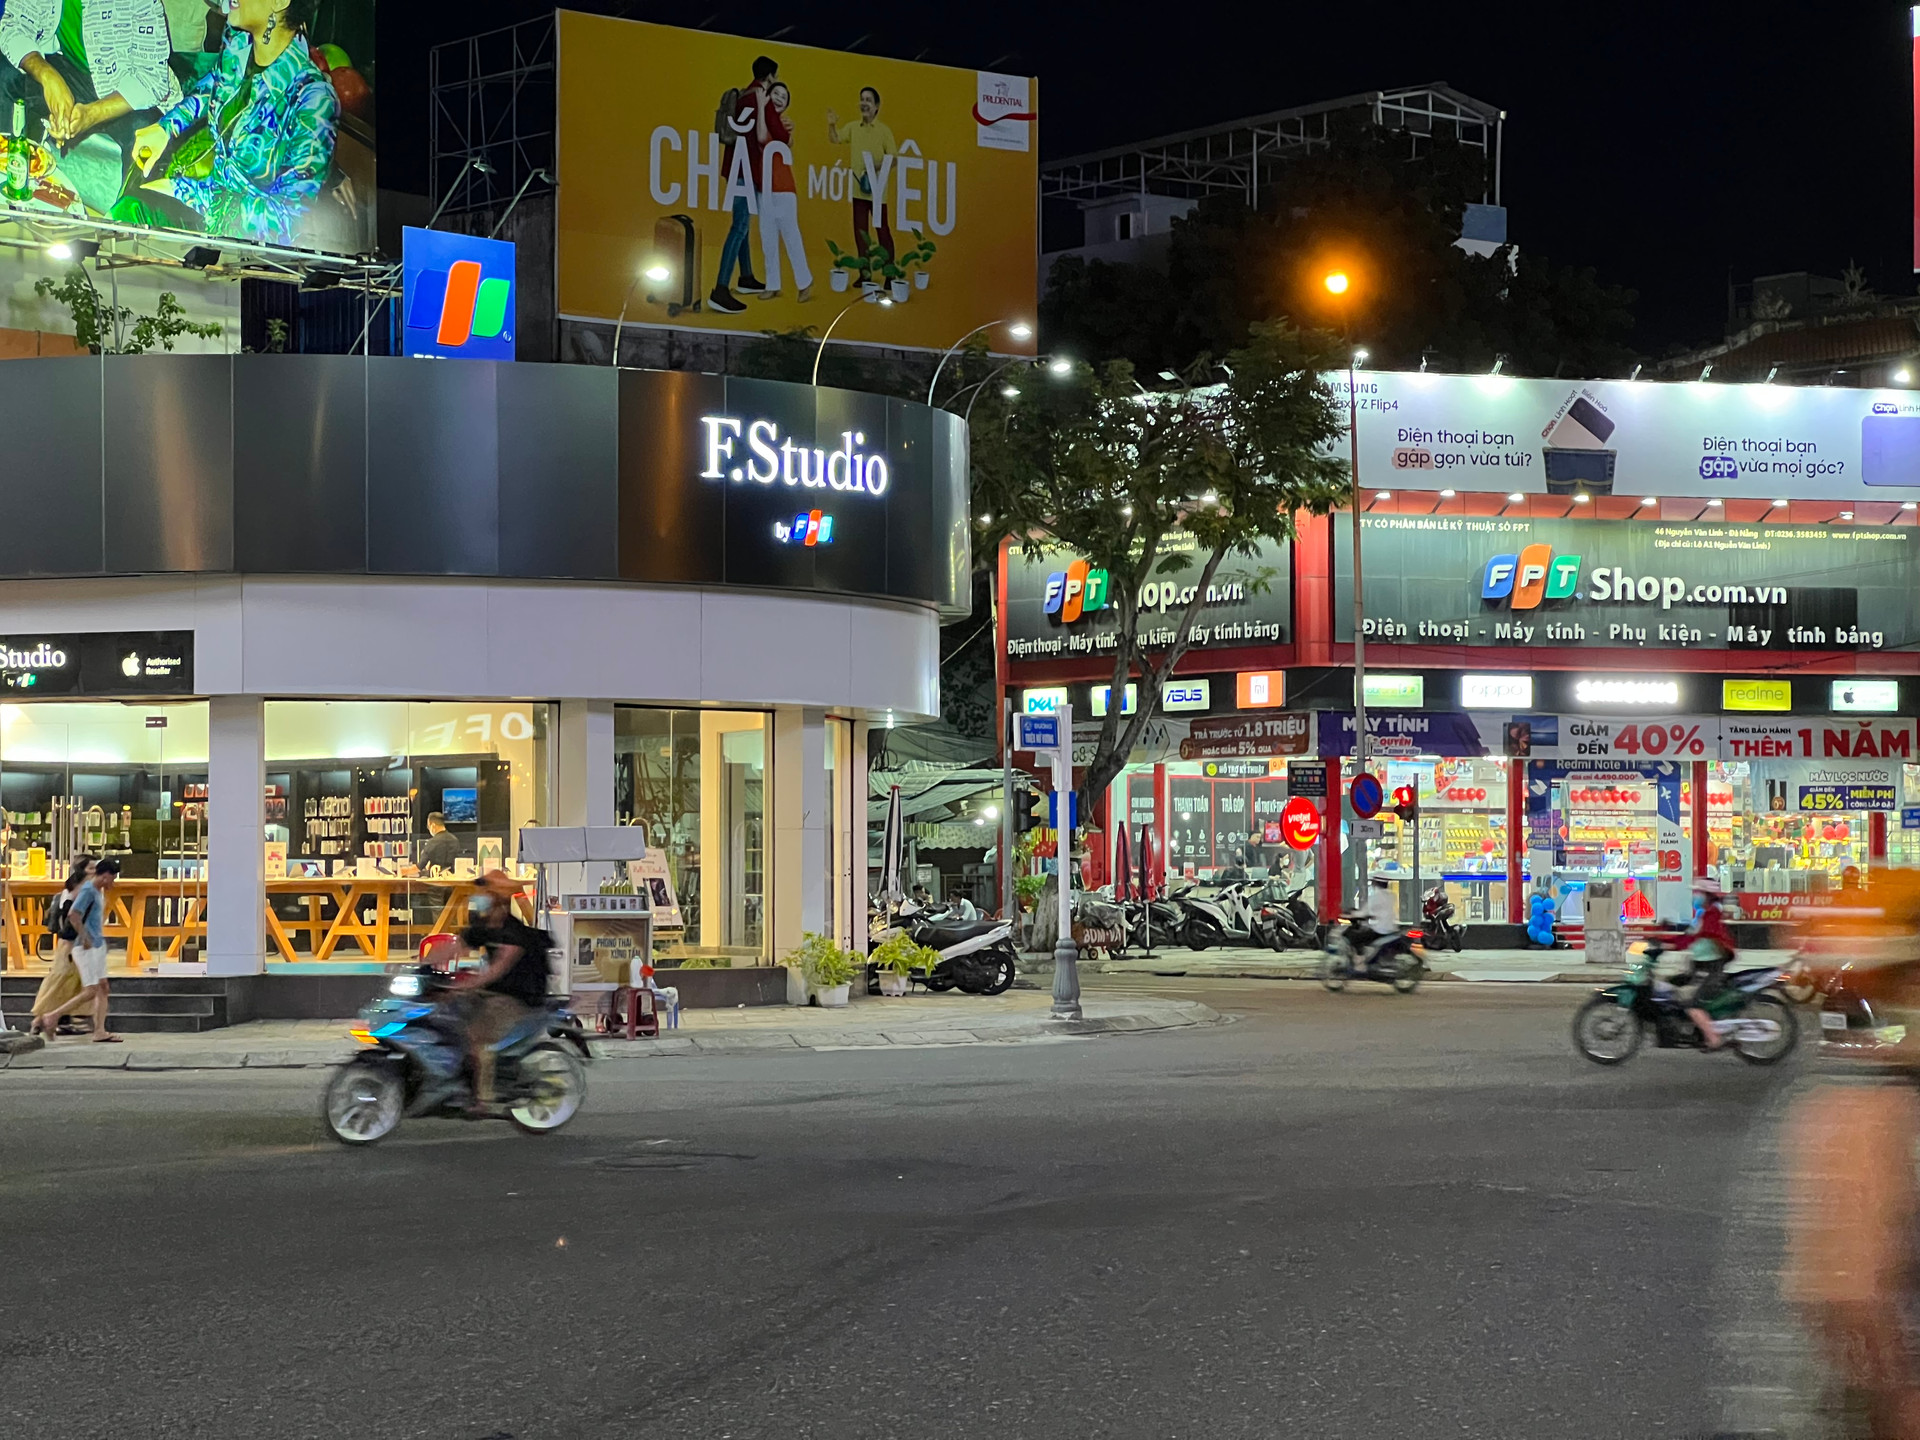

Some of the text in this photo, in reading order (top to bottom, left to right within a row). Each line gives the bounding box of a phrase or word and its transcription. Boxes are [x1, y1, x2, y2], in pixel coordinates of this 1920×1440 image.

[982, 95, 1023, 107] PRUDENTIAL
[808, 160, 853, 203] MỚI
[861, 139, 957, 236] YÊU
[1371, 398, 1398, 413] Flip4
[1398, 428, 1514, 449] Điện thoại bạn
[1703, 437, 1817, 457] Điện thoại bạn
[700, 415, 888, 496] F.Studio
[1397, 450, 1532, 469] gập gọn vừa túi?
[1702, 456, 1845, 478] gập vừa mọi góc?
[774, 520, 791, 542] by
[1360, 518, 1373, 528] TY
[1417, 517, 1436, 530] BÁN
[1466, 520, 1496, 533] THUẬT
[1513, 523, 1530, 533] FPT
[1007, 638, 1032, 657] Điện
[1033, 637, 1062, 654] thoại
[1069, 634, 1094, 653] Máy
[1214, 621, 1241, 640] tính
[1242, 619, 1280, 641] bảng
[1362, 618, 1884, 648] Điện thoại Máy tính Phụ kiện Máy tính bảng
[1166, 688, 1203, 703] ASUS
[1730, 686, 1784, 701] realme
[1245, 722, 1263, 737] 1.8
[1264, 716, 1306, 740] TRIỆU
[1386, 714, 1429, 733] TÍNH
[1570, 719, 1609, 737] GIẢM
[1238, 740, 1256, 755] 5%
[1258, 745, 1272, 753] QUA
[1577, 738, 1609, 755] ĐẾN
[1613, 724, 1705, 756] 40%
[1730, 735, 1793, 757] THÊM
[1797, 721, 1911, 758] 1 NĂM
[1556, 760, 1591, 770] Redmi
[1595, 760, 1621, 770] Note
[1625, 760, 1636, 770] 11
[1809, 769, 1889, 784] MÁY LỌC NƯỚC
[1801, 793, 1844, 810] 45%
[1876, 788, 1895, 799] PHÍ
[1757, 893, 1790, 906] HÀNG
